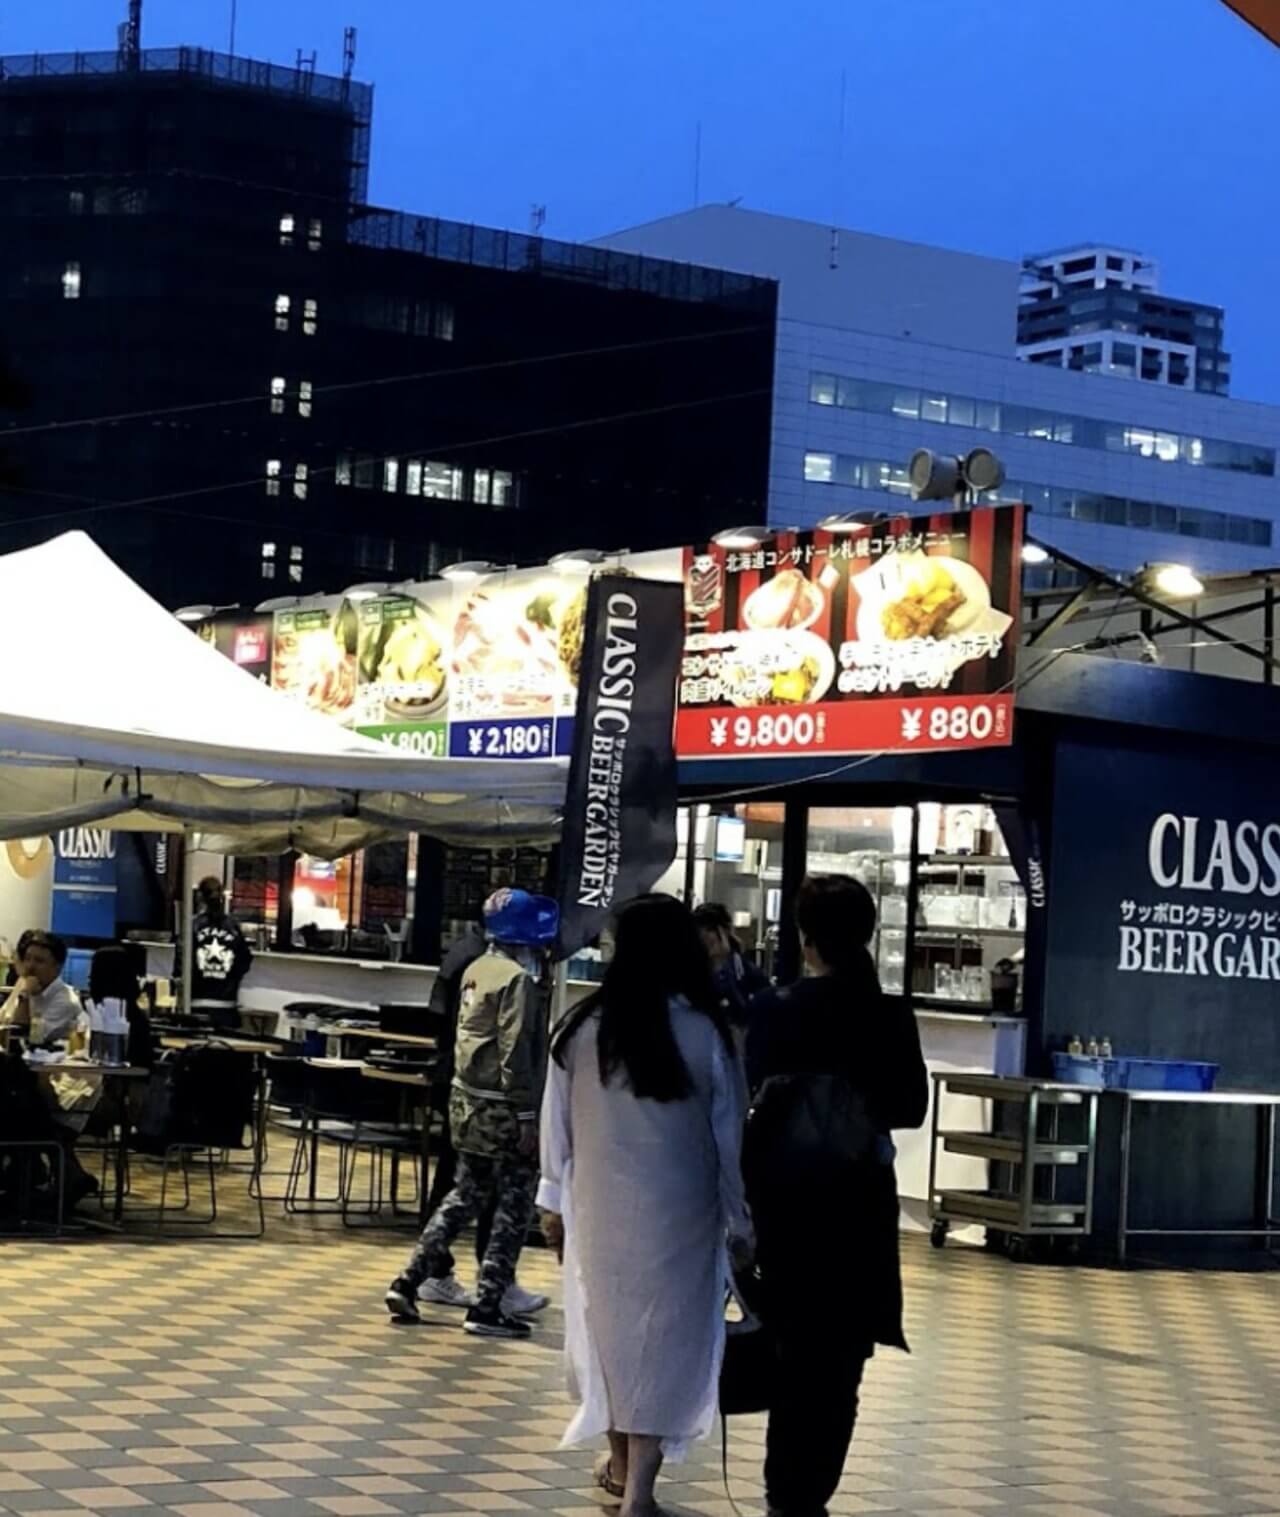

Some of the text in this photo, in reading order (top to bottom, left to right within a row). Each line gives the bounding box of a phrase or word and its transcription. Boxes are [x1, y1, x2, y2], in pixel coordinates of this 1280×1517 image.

[592, 592, 639, 734] CLASSIC
[1026, 856, 1047, 908] CLASSIC
[1119, 899, 1280, 933] サッポロクラシックビ
